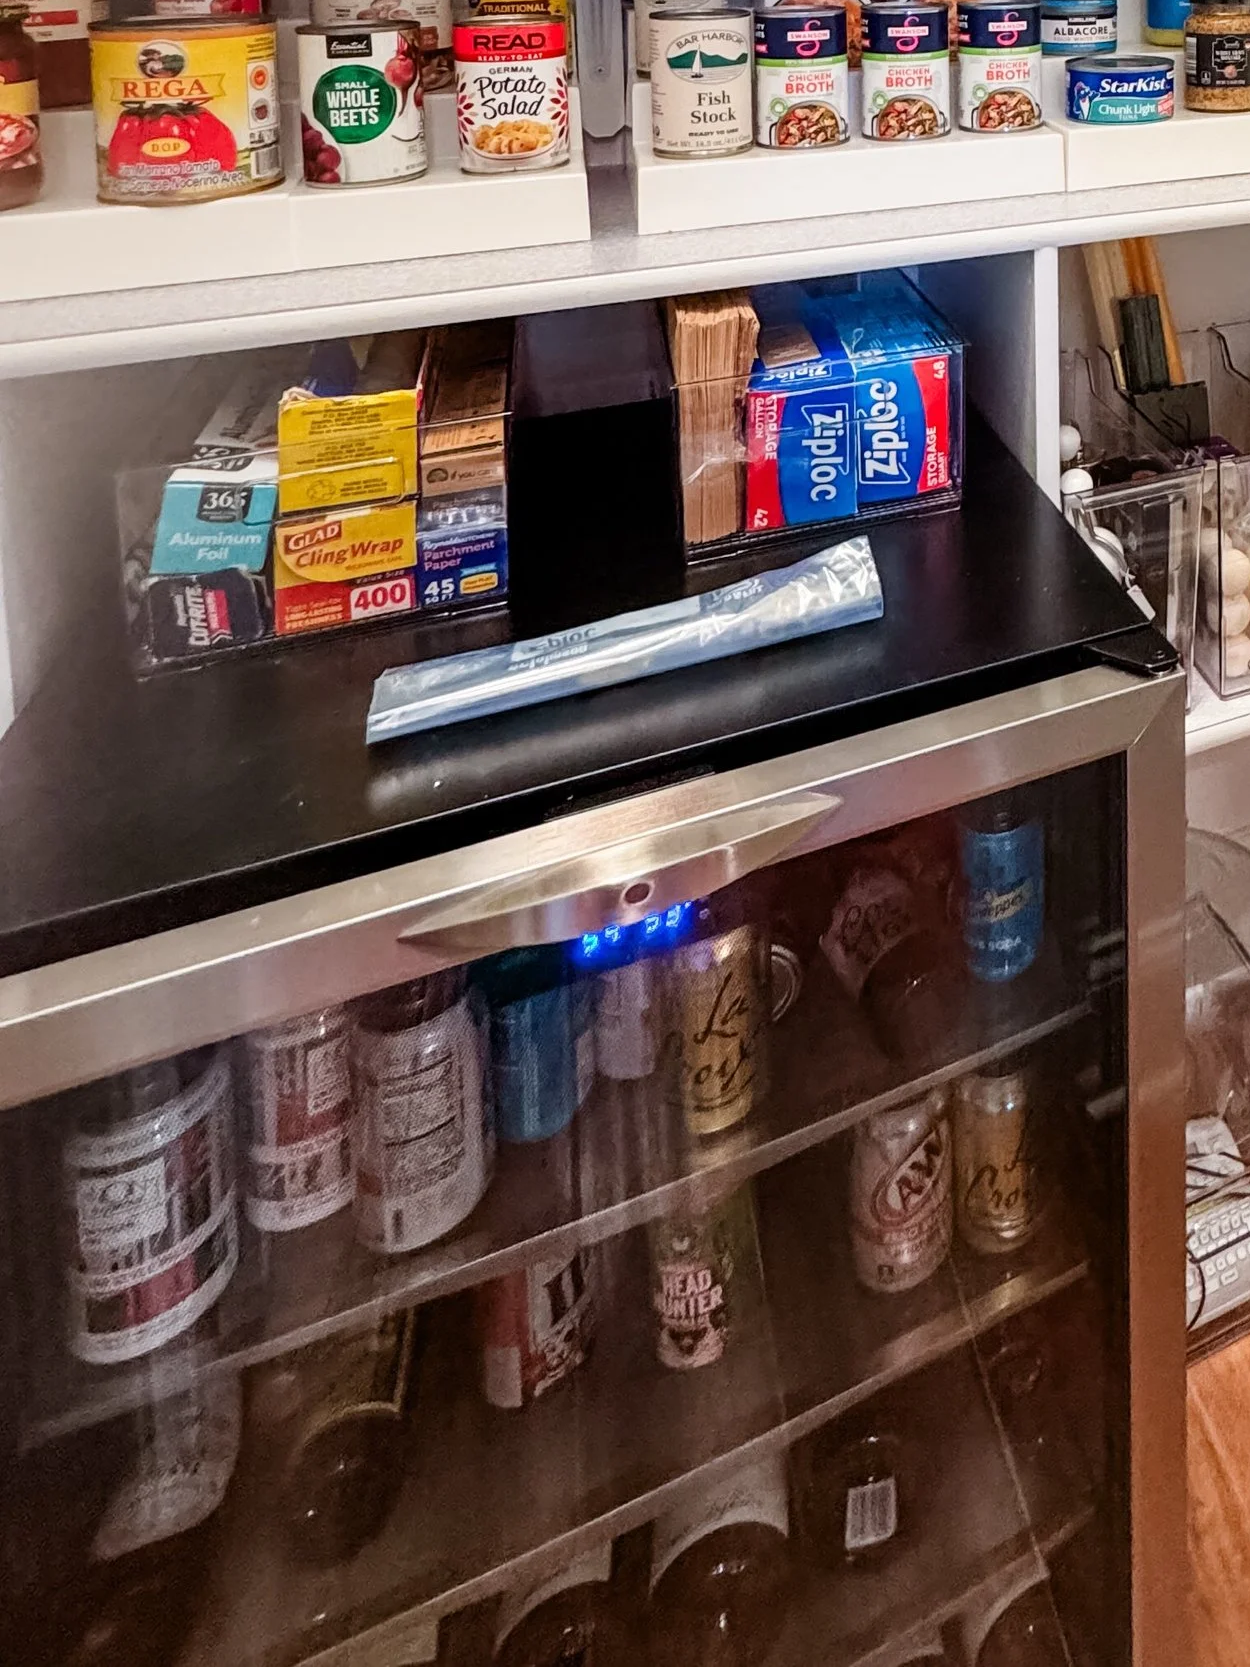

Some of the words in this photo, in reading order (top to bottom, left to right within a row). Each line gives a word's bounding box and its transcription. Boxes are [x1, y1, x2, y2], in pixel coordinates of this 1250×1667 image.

[483, 3, 547, 13] TRADITIONAL
[790, 32, 828, 40] SWANSON
[1053, 25, 1108, 36] ALBACORE
[473, 32, 547, 51] READ
[676, 36, 699, 49] BAR
[477, 52, 543, 62] READY-TO-EAT
[988, 61, 1029, 70] CHICKEN
[488, 66, 534, 75] GERMAN
[787, 72, 832, 83] CHICKEN
[888, 68, 930, 77] CHICKEN
[986, 68, 1031, 81] BROTH
[122, 78, 209, 99] REGA
[334, 81, 370, 90] SMALL
[474, 74, 546, 98] Potato
[785, 80, 834, 94] BROTH
[885, 75, 933, 88] BROTH
[1099, 76, 1166, 94] StarKist
[325, 89, 381, 109] WHOLE
[696, 90, 731, 107] Fish
[480, 96, 545, 120] Salad
[690, 107, 737, 125] Stock
[1098, 103, 1133, 115] Chunk
[1134, 103, 1156, 116] Light
[330, 108, 380, 128] BEETS
[180, 158, 220, 173] Tomato
[171, 174, 219, 191] Nocerino
[221, 171, 244, 183] Area
[932, 360, 945, 380] 48
[754, 397, 765, 440] GALLON
[763, 395, 779, 461] STORAGE
[857, 381, 908, 479] Ziploc
[801, 409, 844, 503] Ziploc
[925, 426, 938, 487] STORAGE
[458, 470, 477, 482] you
[937, 451, 946, 485] QUART
[202, 489, 249, 512] 365
[753, 507, 769, 528] 42
[168, 531, 262, 547] Aluminum
[288, 523, 340, 551] GLAD
[423, 538, 459, 551] Reynolds
[196, 547, 229, 562] Foil
[295, 547, 350, 569] Cling
[350, 537, 404, 558] Wrap
[423, 540, 496, 561] Parchment
[424, 556, 462, 572] Paper
[424, 577, 455, 597] 45
[354, 582, 406, 611] 400
[425, 595, 440, 605] SQ
[441, 593, 453, 603] FT
[662, 1268, 712, 1297] HEAD
